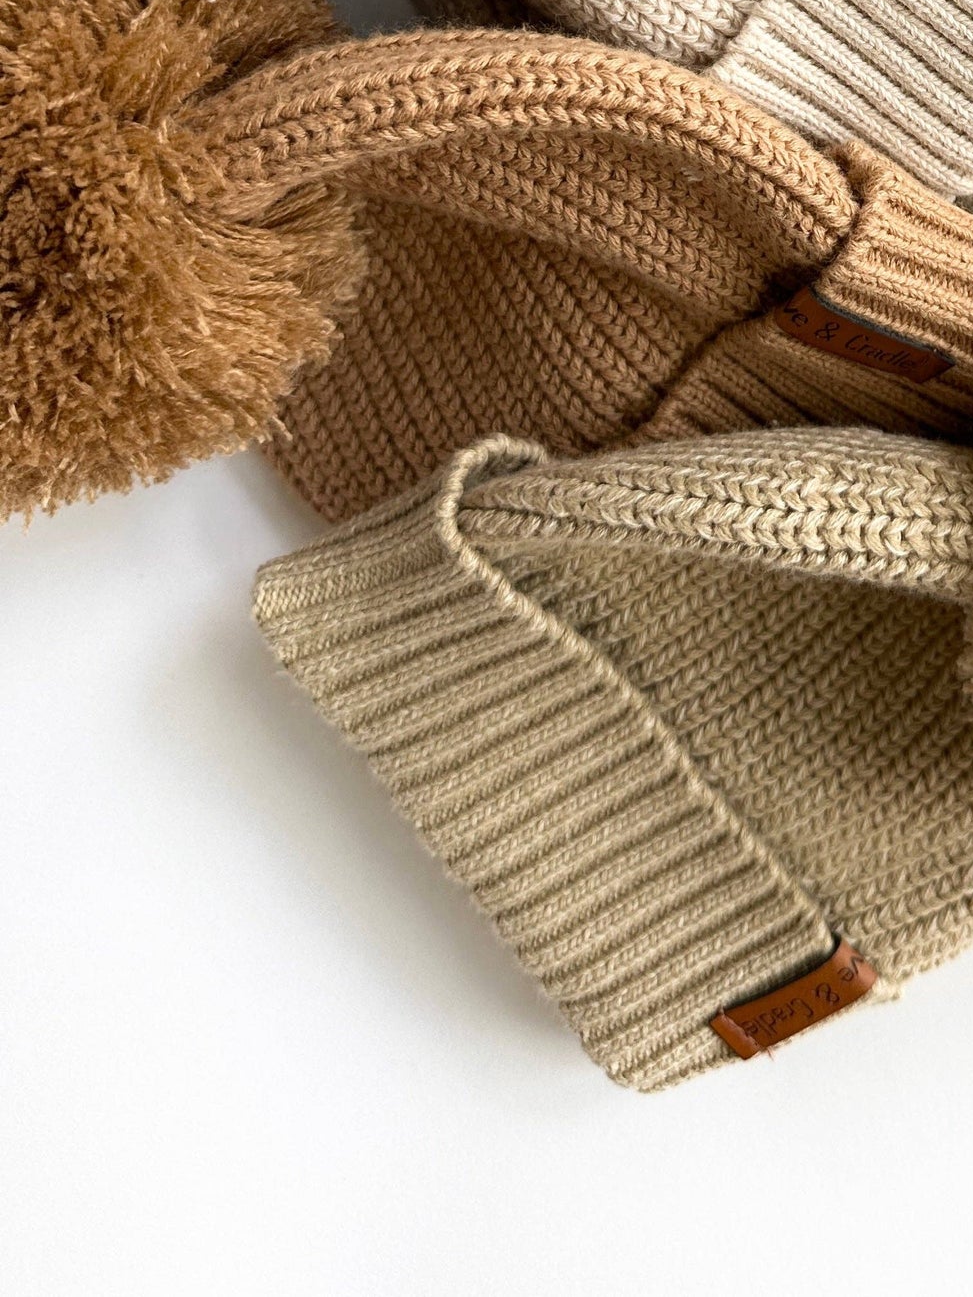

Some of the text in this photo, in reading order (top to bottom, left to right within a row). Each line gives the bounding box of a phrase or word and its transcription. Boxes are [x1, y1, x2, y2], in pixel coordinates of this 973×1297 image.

[815, 321, 840, 342] &
[814, 982, 841, 1007] &
[739, 997, 814, 1038] Cradle
